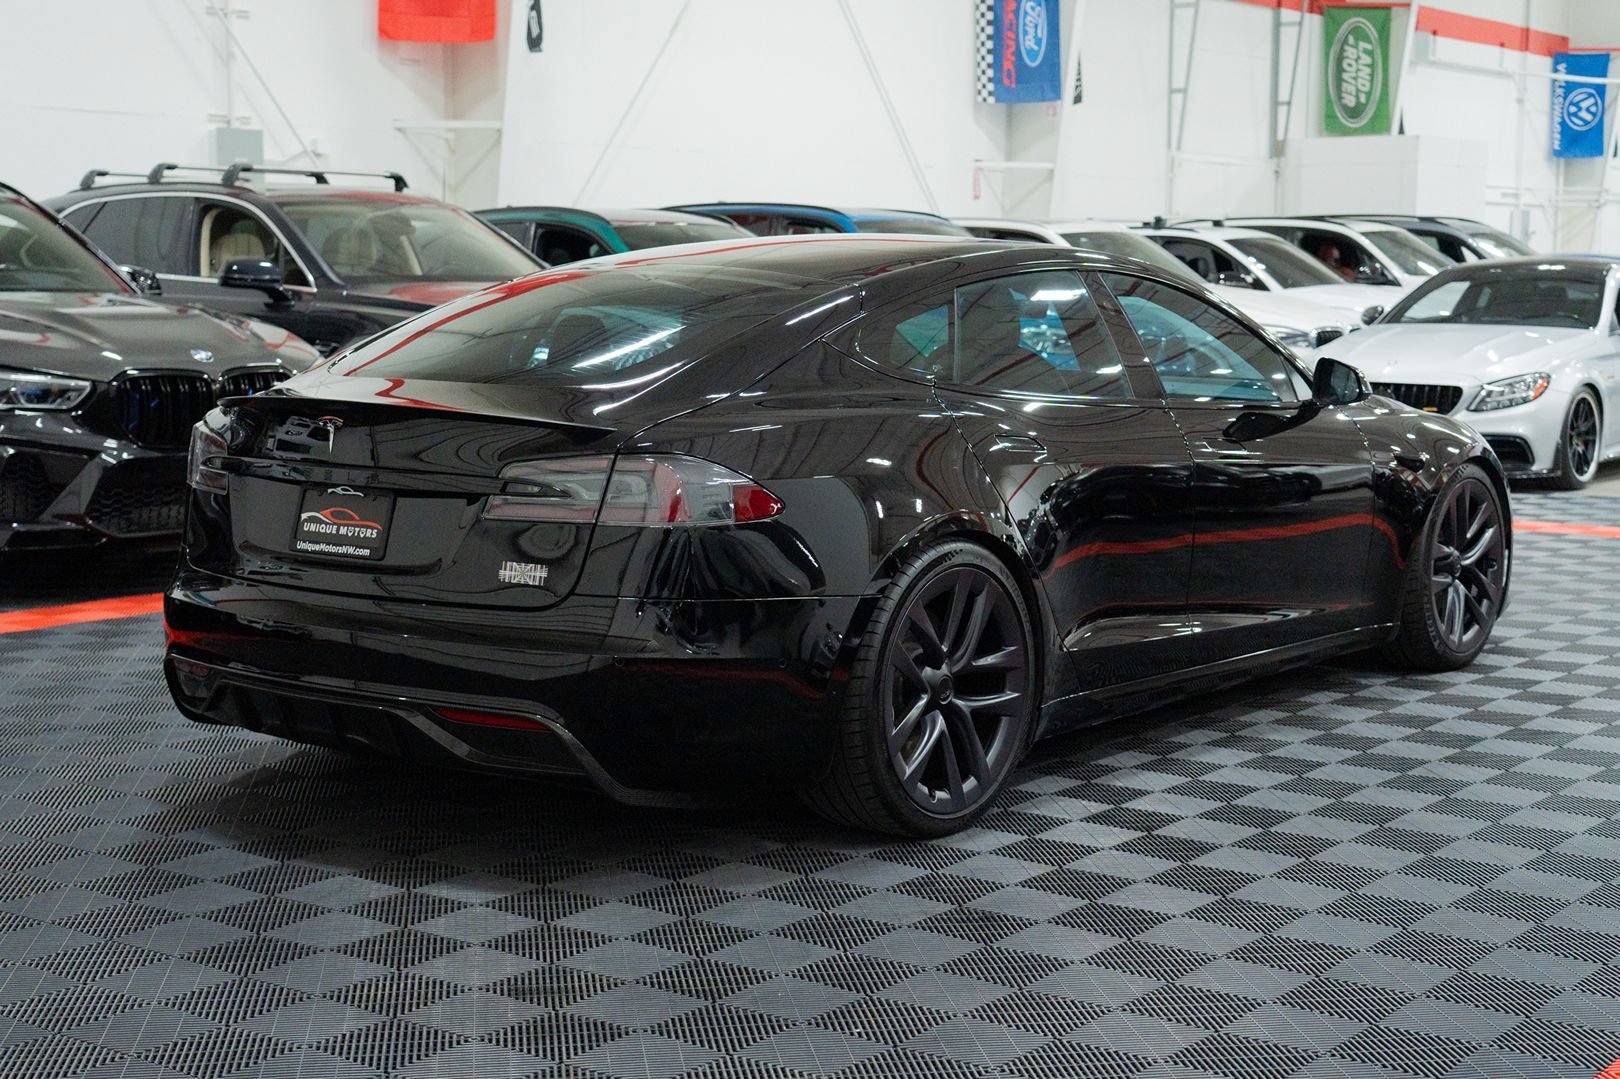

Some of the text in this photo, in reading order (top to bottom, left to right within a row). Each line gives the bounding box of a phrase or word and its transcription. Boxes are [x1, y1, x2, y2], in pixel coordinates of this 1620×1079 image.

[1003, 0, 1017, 89] ACING
[1025, 1, 1041, 51] Ford
[1552, 62, 1568, 150] VLKSWAGEN
[296, 541, 370, 557] UniqueMotorsNW.com
[303, 522, 337, 534] UNIQUE
